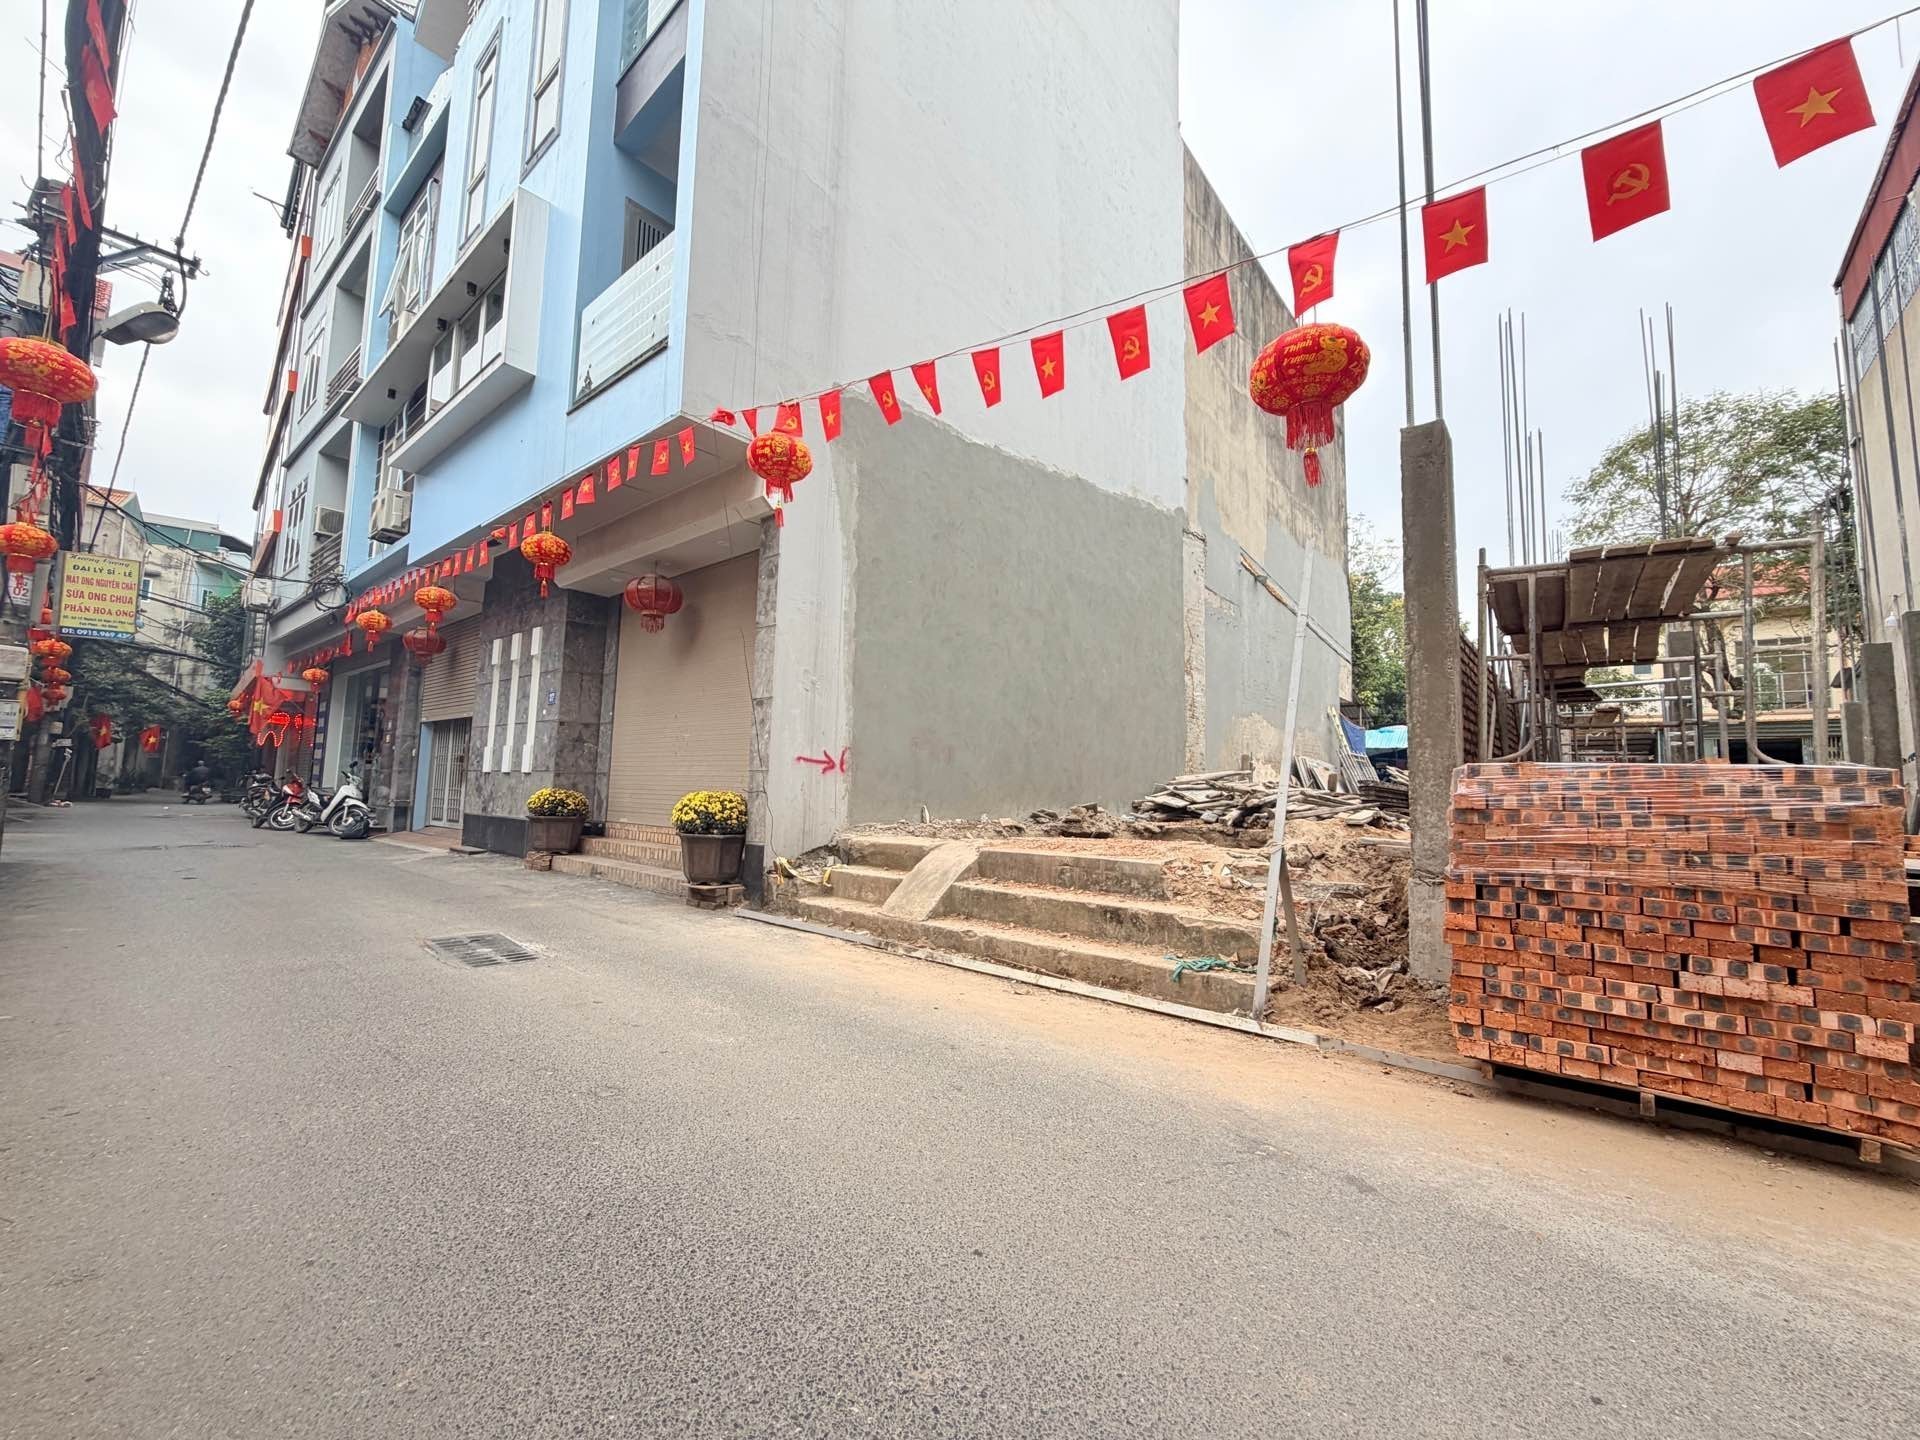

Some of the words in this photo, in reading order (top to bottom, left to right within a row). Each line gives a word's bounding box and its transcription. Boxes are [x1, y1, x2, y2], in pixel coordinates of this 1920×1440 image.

[88, 591, 107, 602] ONG
[92, 606, 113, 617] HOA
[115, 609, 135, 618] ONG
